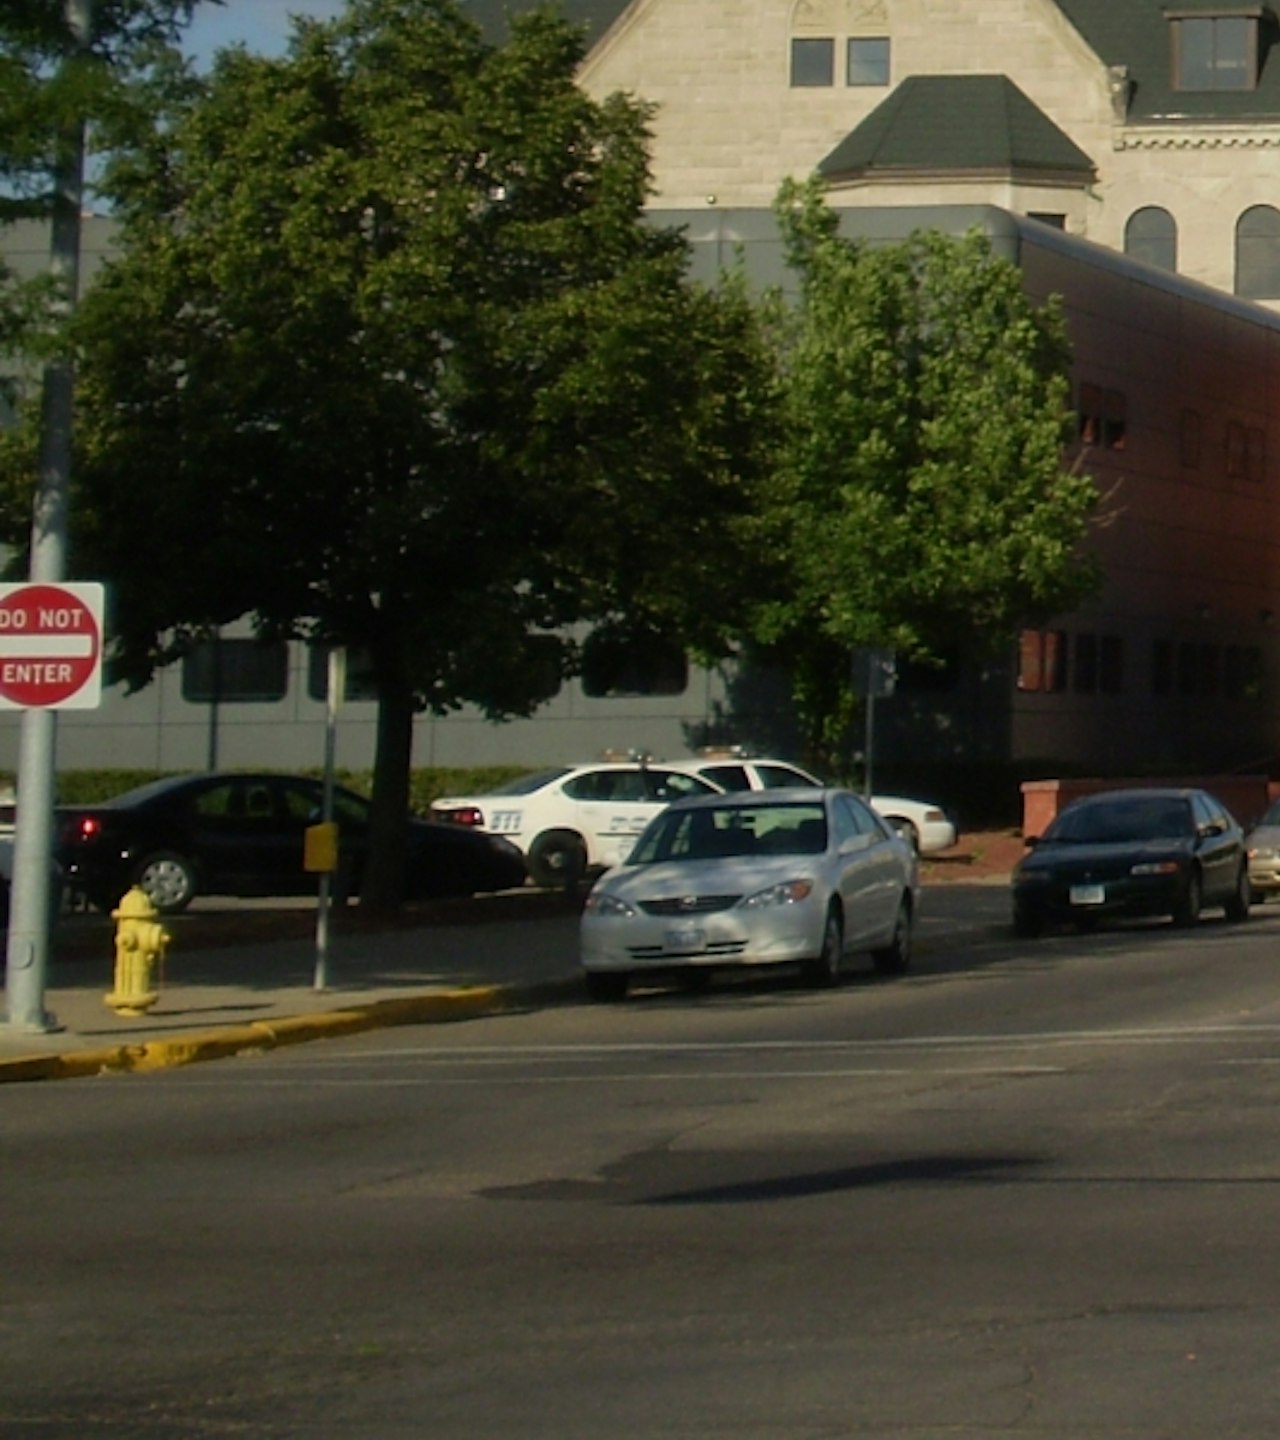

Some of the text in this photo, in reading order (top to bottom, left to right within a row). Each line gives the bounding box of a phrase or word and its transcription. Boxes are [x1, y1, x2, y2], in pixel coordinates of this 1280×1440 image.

[0, 608, 83, 629] DO NOT
[3, 663, 72, 683] ENTER
